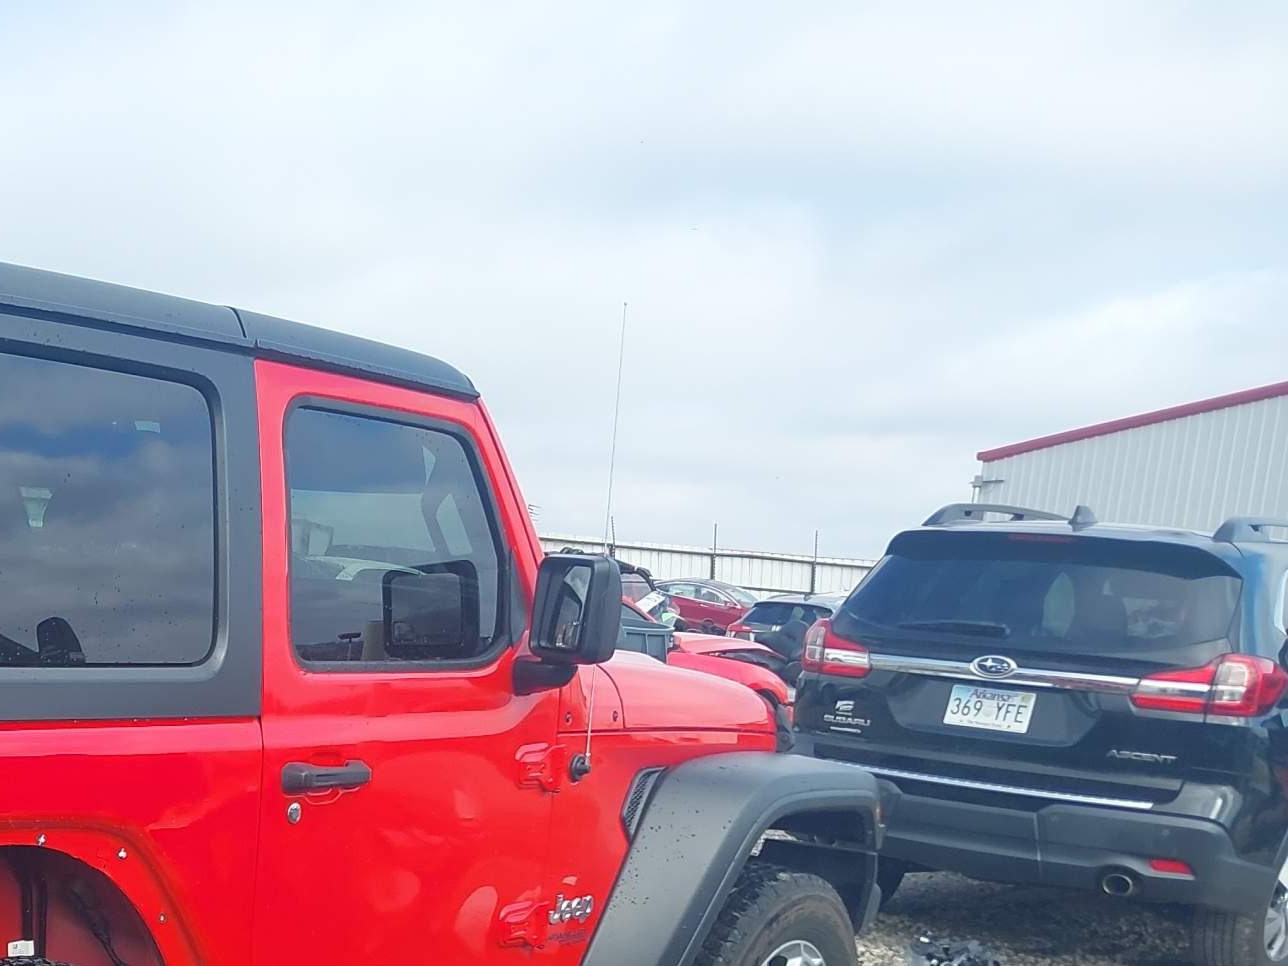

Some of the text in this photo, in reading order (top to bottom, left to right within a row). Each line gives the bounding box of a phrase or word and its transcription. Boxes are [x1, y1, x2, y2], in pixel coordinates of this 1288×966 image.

[950, 697, 1028, 724] 369 YFE
[548, 894, 593, 924] Jeep
